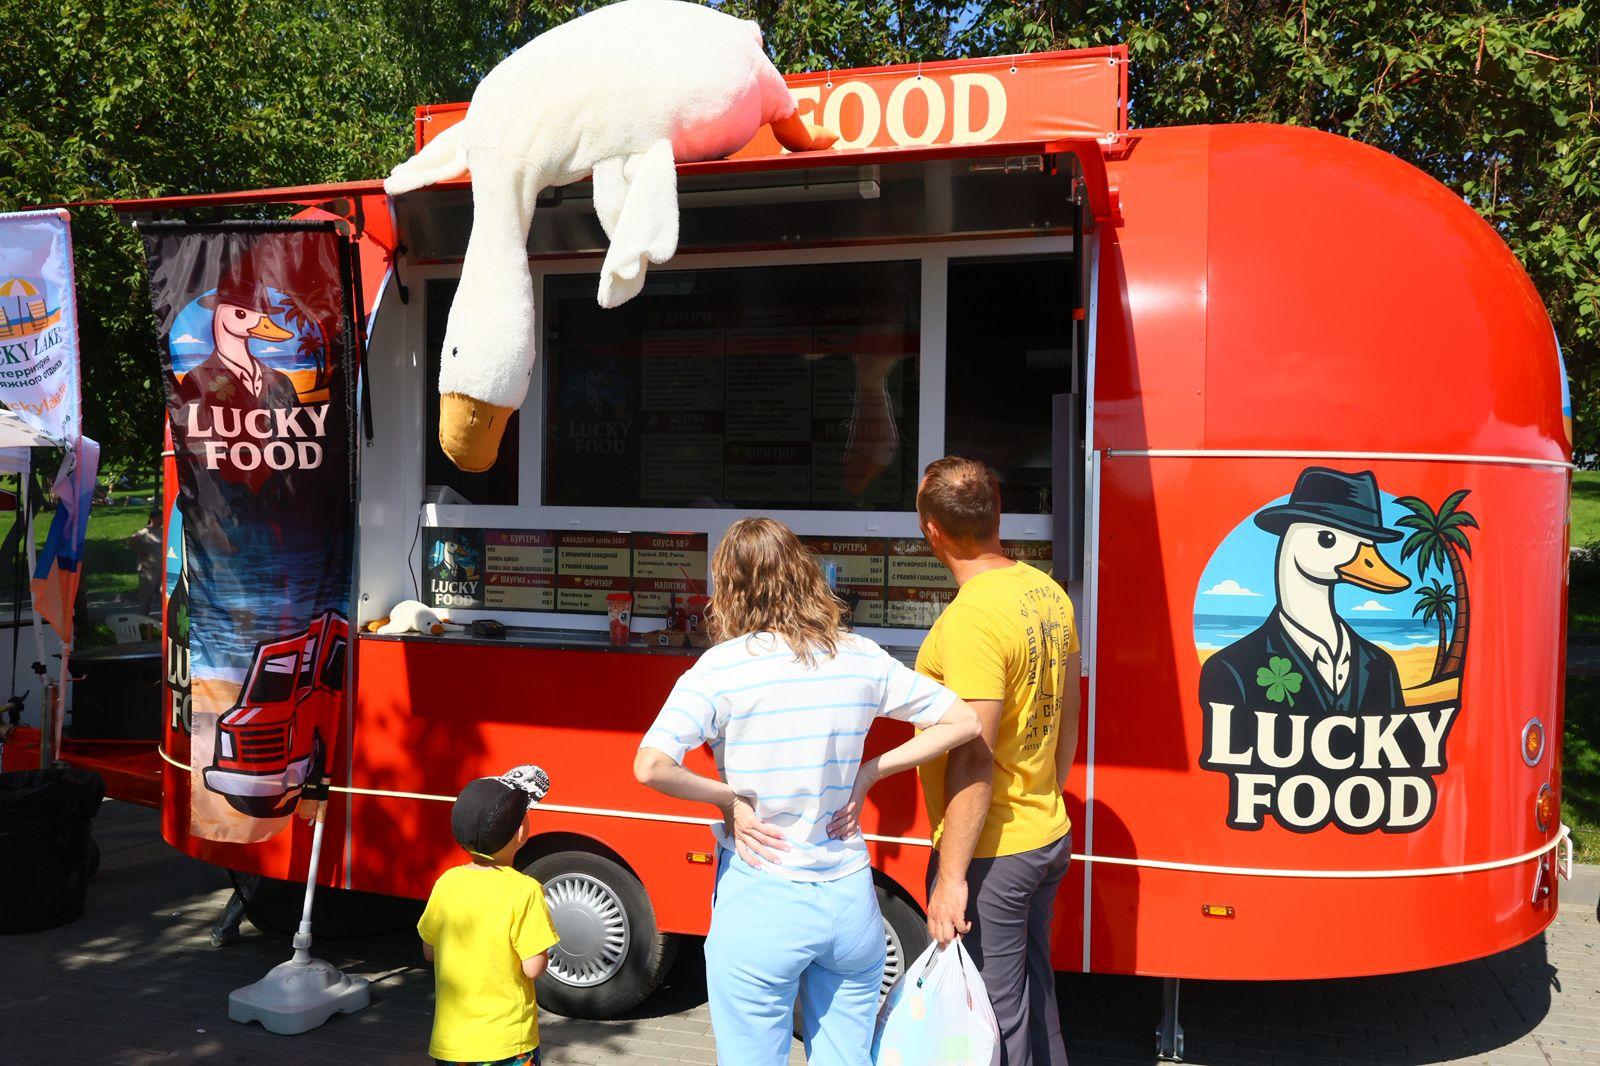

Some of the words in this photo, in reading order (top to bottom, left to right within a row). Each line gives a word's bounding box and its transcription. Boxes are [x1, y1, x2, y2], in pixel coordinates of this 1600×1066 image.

[34, 327, 63, 356] LAKE
[0, 355, 50, 379] территория
[43, 360, 63, 379] отдыха
[187, 403, 330, 438] LUCKY
[568, 419, 633, 438] LUCKY
[575, 438, 626, 454] FOOD
[203, 441, 323, 471] FOOD
[510, 534, 540, 544] БУРГЕРЫ
[652, 539, 674, 548] СОУСА
[832, 542, 867, 552] БУРГЕРЫ
[431, 579, 478, 594] LUCKY
[500, 575, 526, 585] ШАУРМА
[584, 579, 613, 588] ФРИТЮР
[654, 581, 687, 590] НАПИТКИ
[435, 593, 473, 606] FOOD
[1207, 701, 1455, 770] LUCKY
[1234, 772, 1432, 828] FOOD
